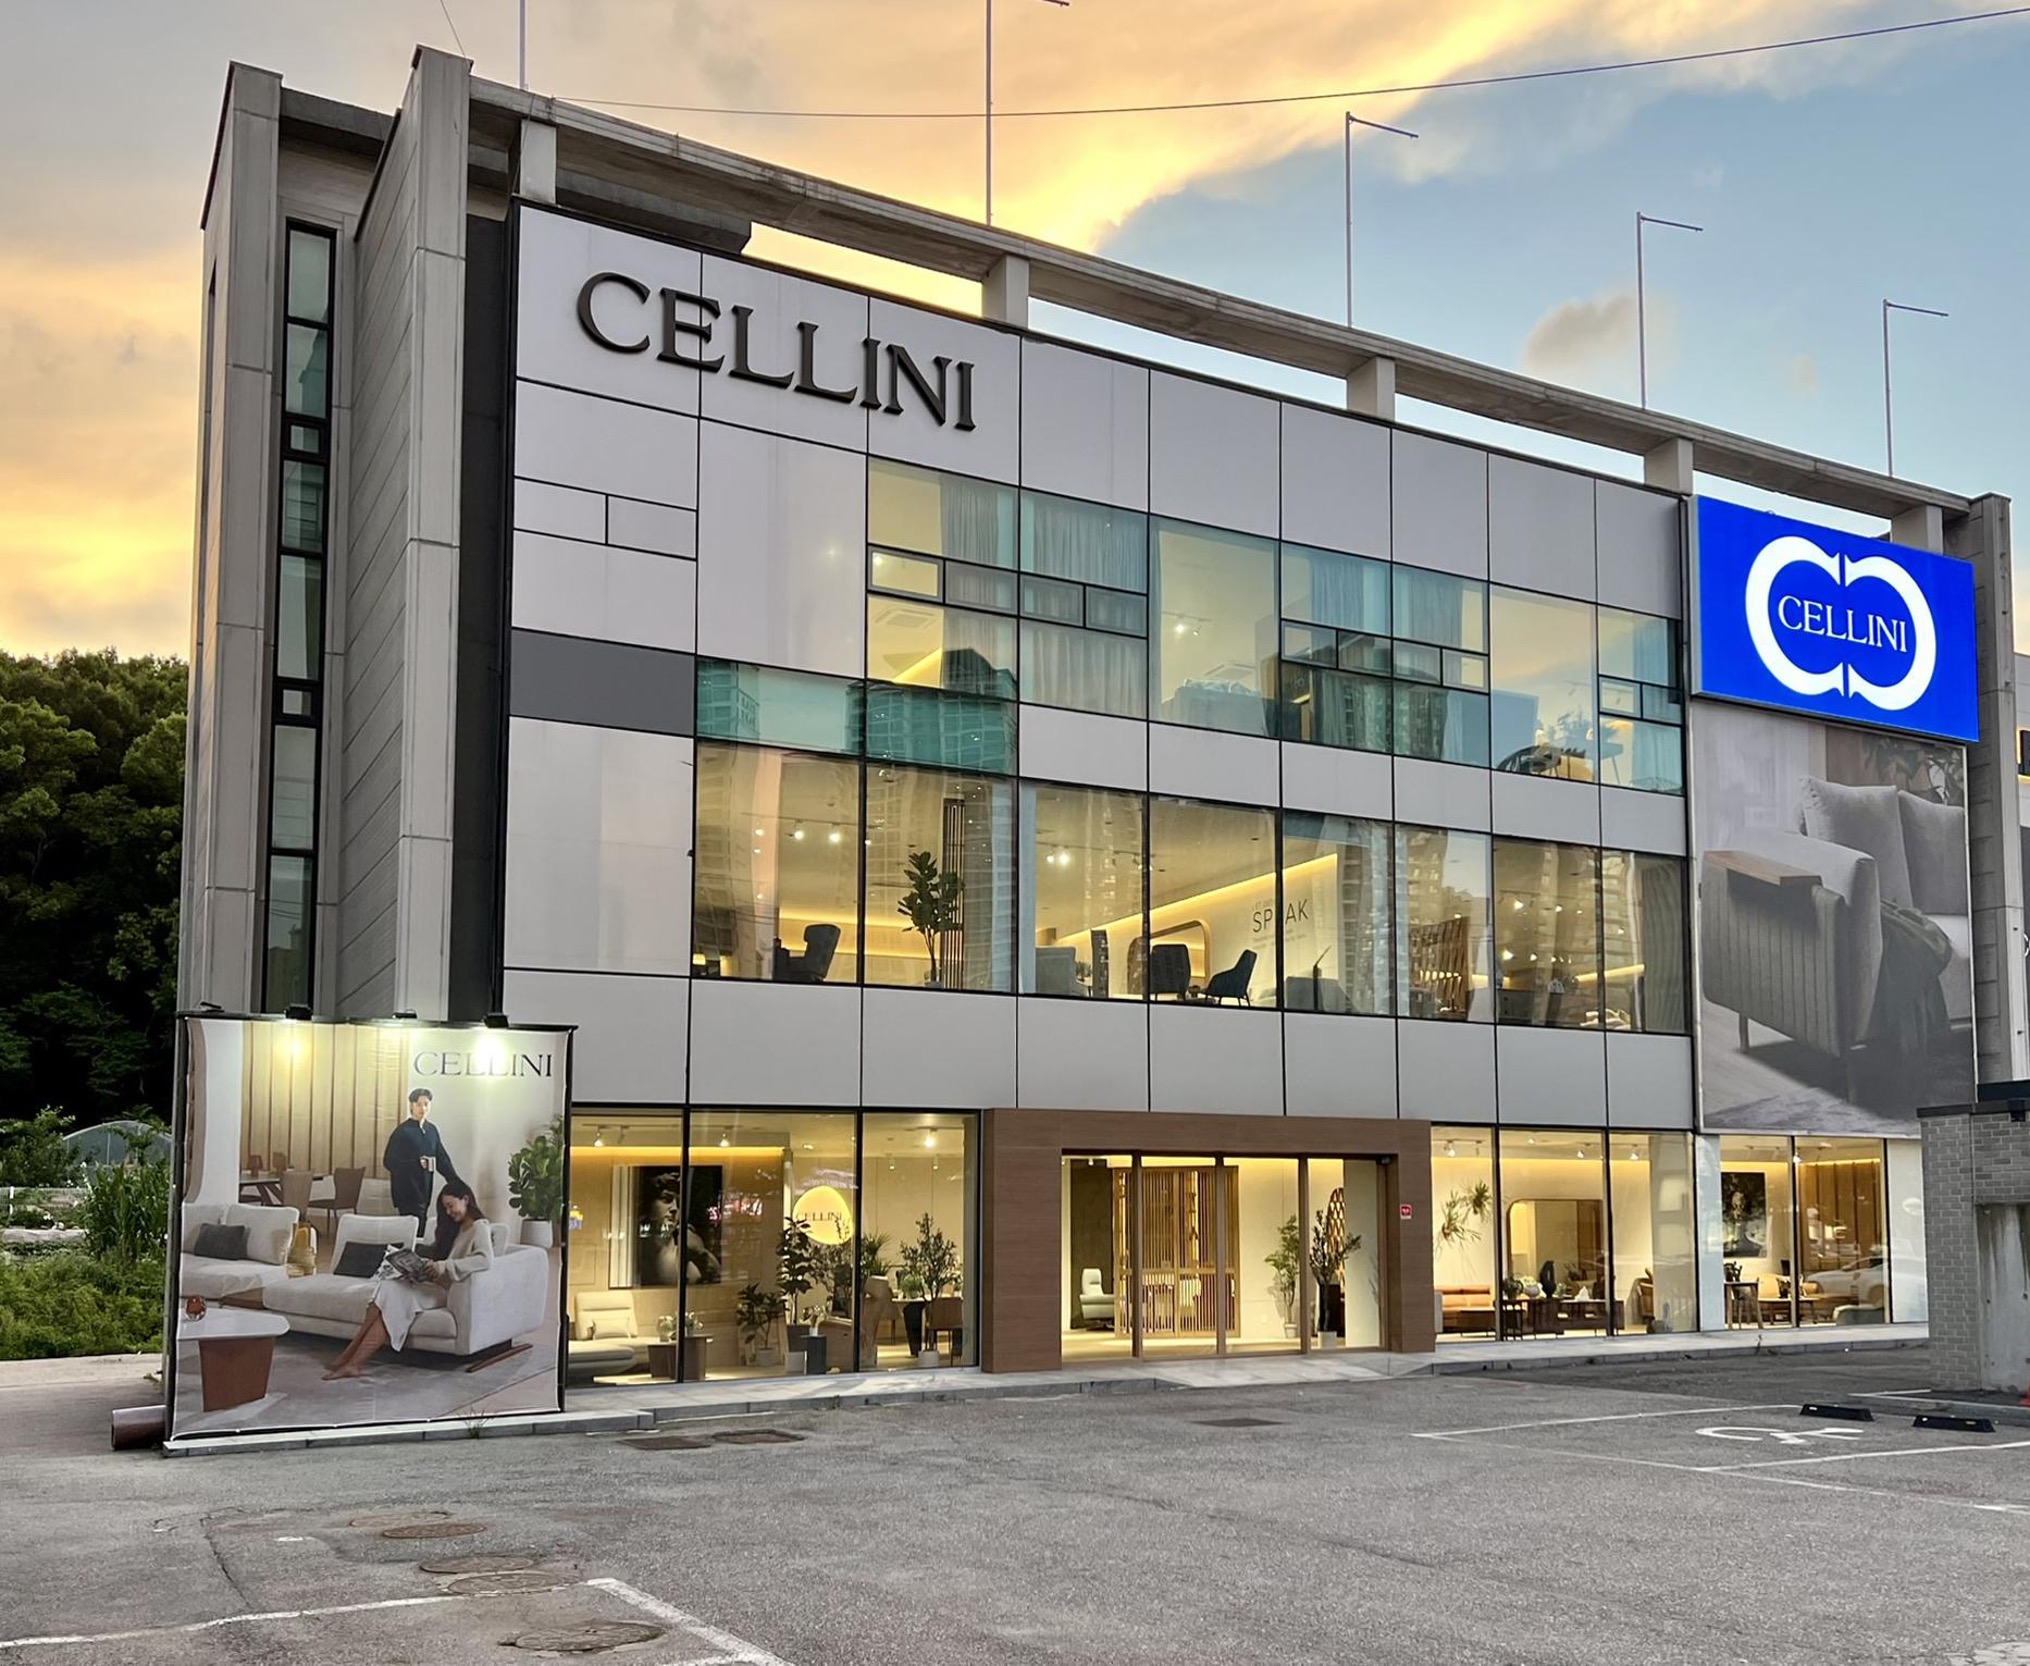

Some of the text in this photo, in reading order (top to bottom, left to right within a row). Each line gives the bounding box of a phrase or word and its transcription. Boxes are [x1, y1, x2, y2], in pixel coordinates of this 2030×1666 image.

[577, 271, 976, 431] CELLINI
[1778, 594, 1908, 653] CELLINI
[1252, 898, 1309, 933] SPAK
[413, 1051, 552, 1077] CELLINI
